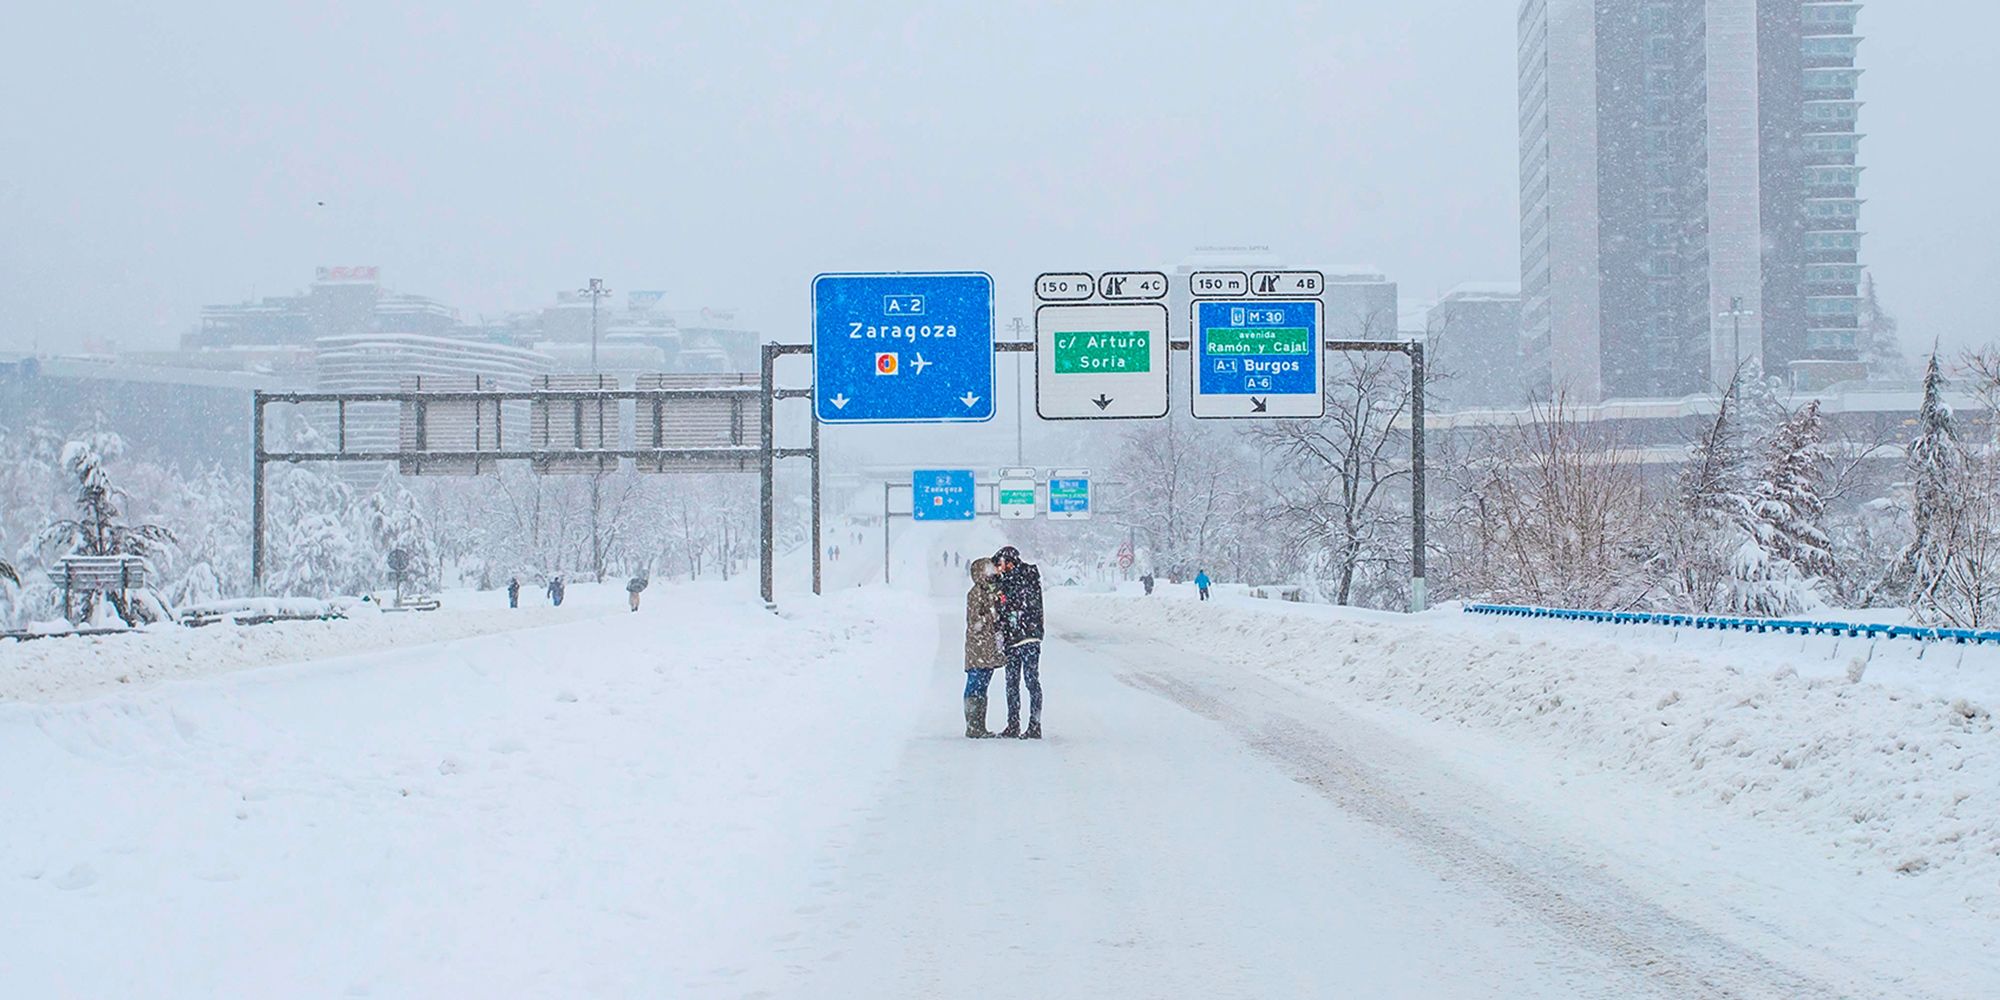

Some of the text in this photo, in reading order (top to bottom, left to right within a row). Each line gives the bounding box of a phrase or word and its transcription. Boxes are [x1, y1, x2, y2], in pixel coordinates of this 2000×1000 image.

[1042, 282, 1087, 292] 150 m
[1140, 280, 1161, 290] 4C
[1199, 279, 1240, 289] 150 m
[1296, 279, 1315, 289] 4B
[888, 299, 921, 312] A-2
[1249, 312, 1282, 322] M-30
[849, 322, 957, 343] Zaragoza
[1059, 336, 1146, 349] c/ Arturo
[1208, 341, 1307, 354] Ramón y Cajal
[1080, 355, 1125, 368] Soria
[1216, 359, 1299, 374] A-1 Burgos
[1247, 378, 1269, 388] A-6
